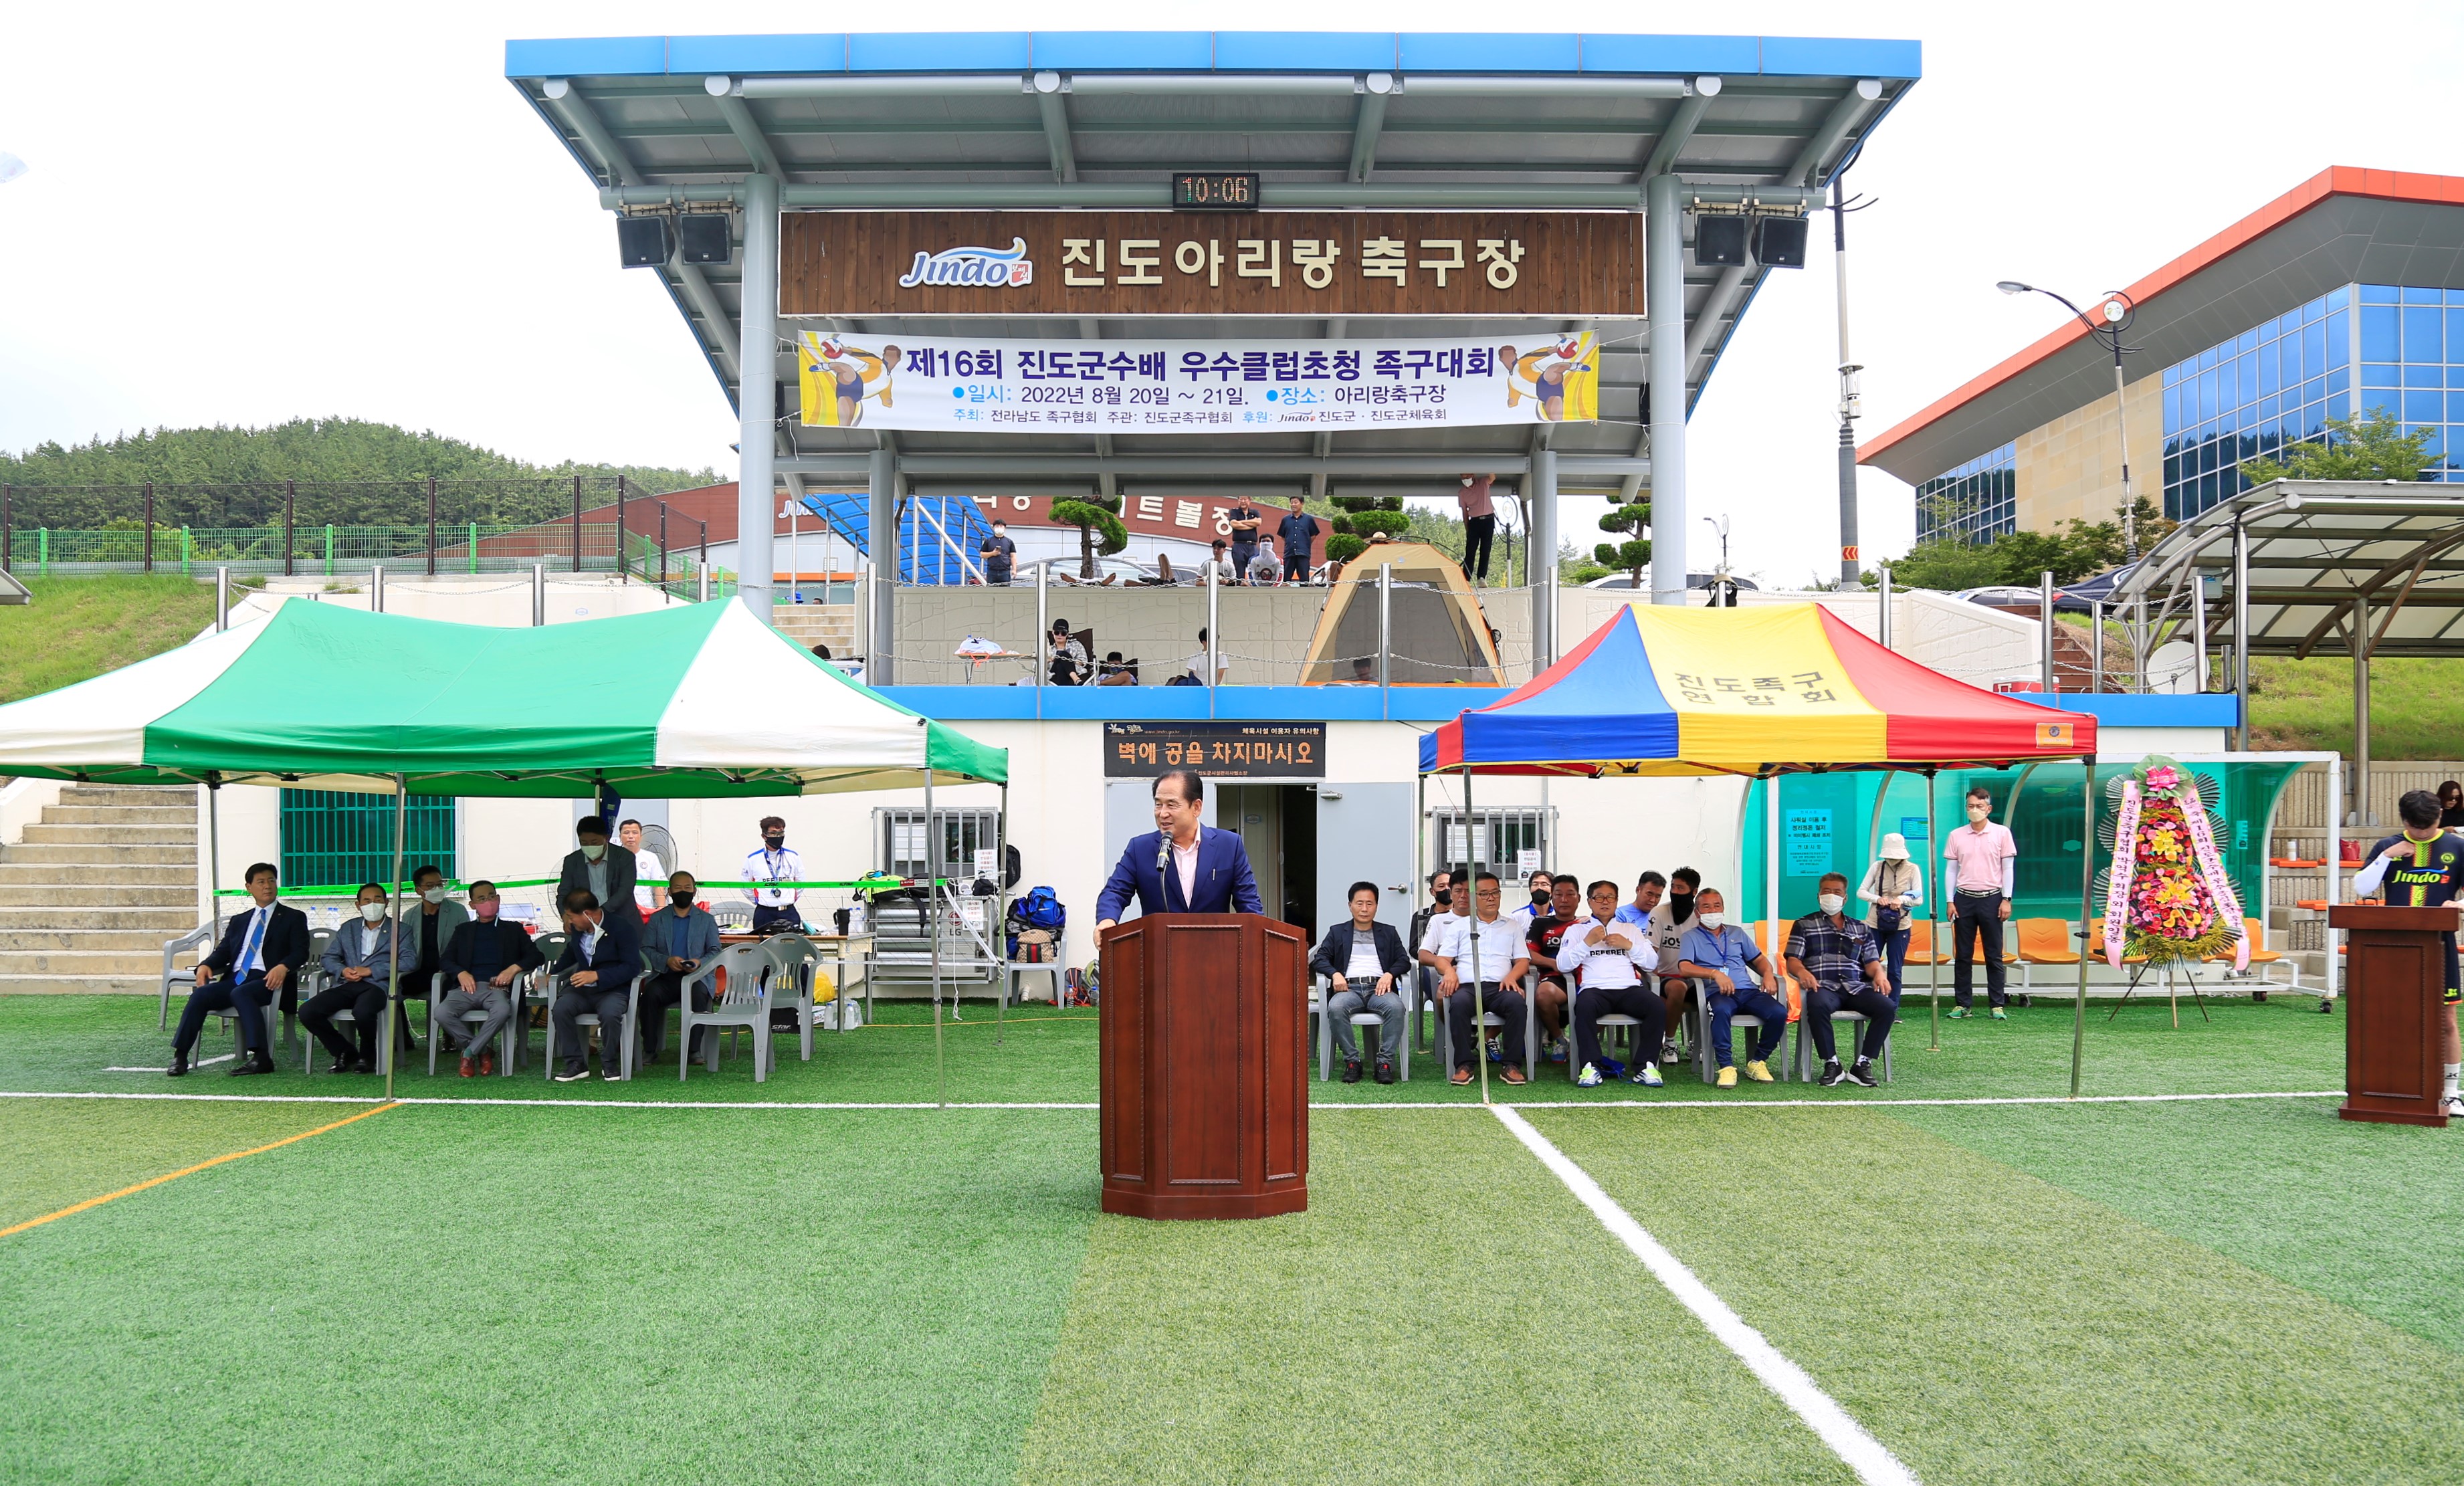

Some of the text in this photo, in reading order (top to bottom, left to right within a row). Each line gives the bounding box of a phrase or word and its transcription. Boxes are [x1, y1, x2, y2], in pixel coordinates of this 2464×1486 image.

[1183, 177, 1247, 202] 10:06
[902, 253, 1008, 284] Jindo
[1062, 237, 1526, 290] 진도아리랑 축구장
[906, 347, 1494, 382] 제16회 진도군수배 우수클럽초청 족구대회
[968, 385, 1012, 403] 일시:
[1021, 387, 1084, 405] 2022년
[1092, 386, 1122, 405] 8월
[1130, 387, 1170, 405] 20일
[1203, 388, 1249, 406] 21일.
[1281, 387, 1326, 405] 장소:
[1335, 385, 1447, 404] 아리랑축구장
[953, 409, 984, 421] 주최:
[991, 410, 1041, 423] 전라남도
[1047, 411, 1097, 424] 족구협회
[1107, 411, 1138, 424] 주관:
[1144, 411, 1233, 424] 진도군족구협회
[1242, 411, 1273, 423] 후원:
[1318, 410, 1356, 423] 진도군
[1370, 409, 1447, 421] 진도군체육회
[1118, 741, 1314, 765] 벽에 공을 차지마시오
[2392, 870, 2441, 883] Jindo
[950, 928, 962, 936] LG
